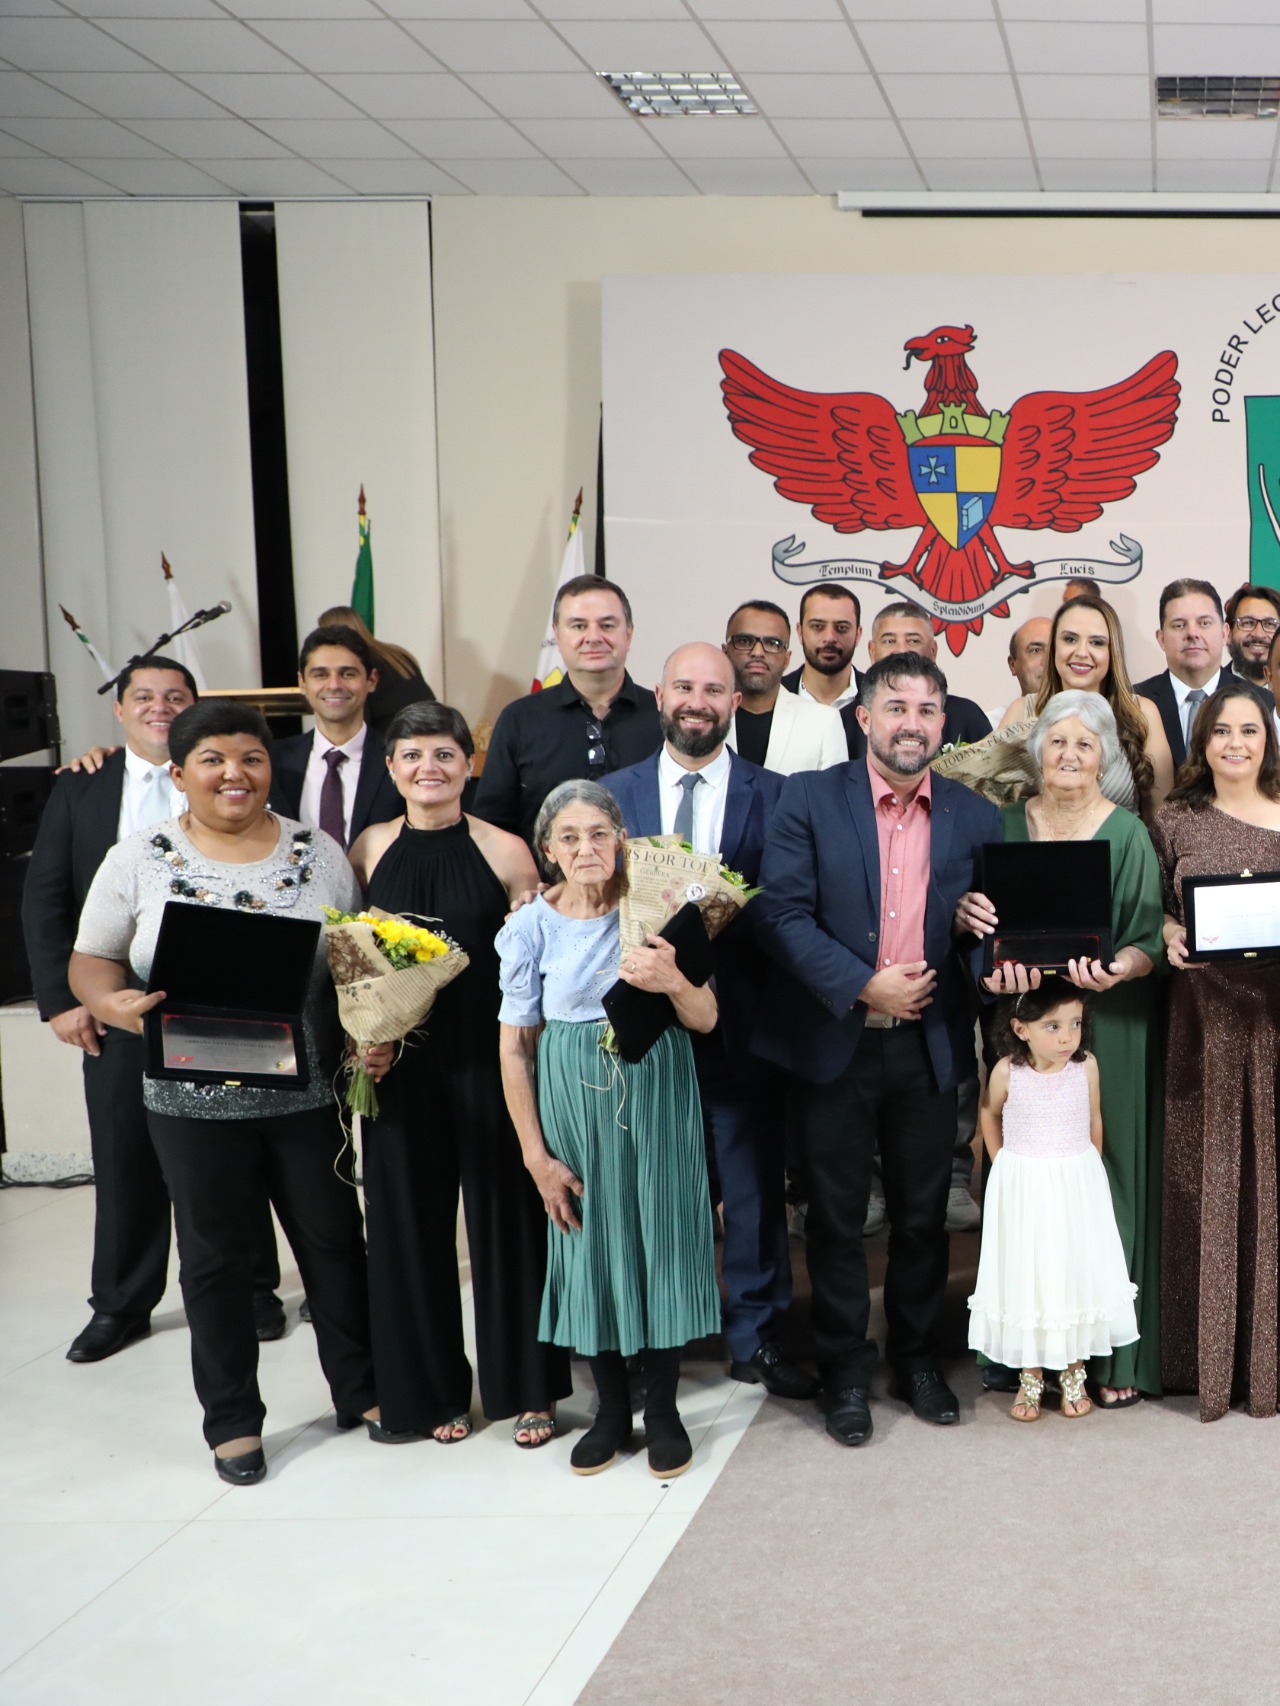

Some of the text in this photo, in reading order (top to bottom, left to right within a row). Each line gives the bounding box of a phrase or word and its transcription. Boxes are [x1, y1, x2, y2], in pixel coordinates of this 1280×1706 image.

[1212, 334, 1249, 423] PODER
[819, 562, 1095, 616] Templum Splendidum Lucis
[644, 850, 675, 866] FOR
